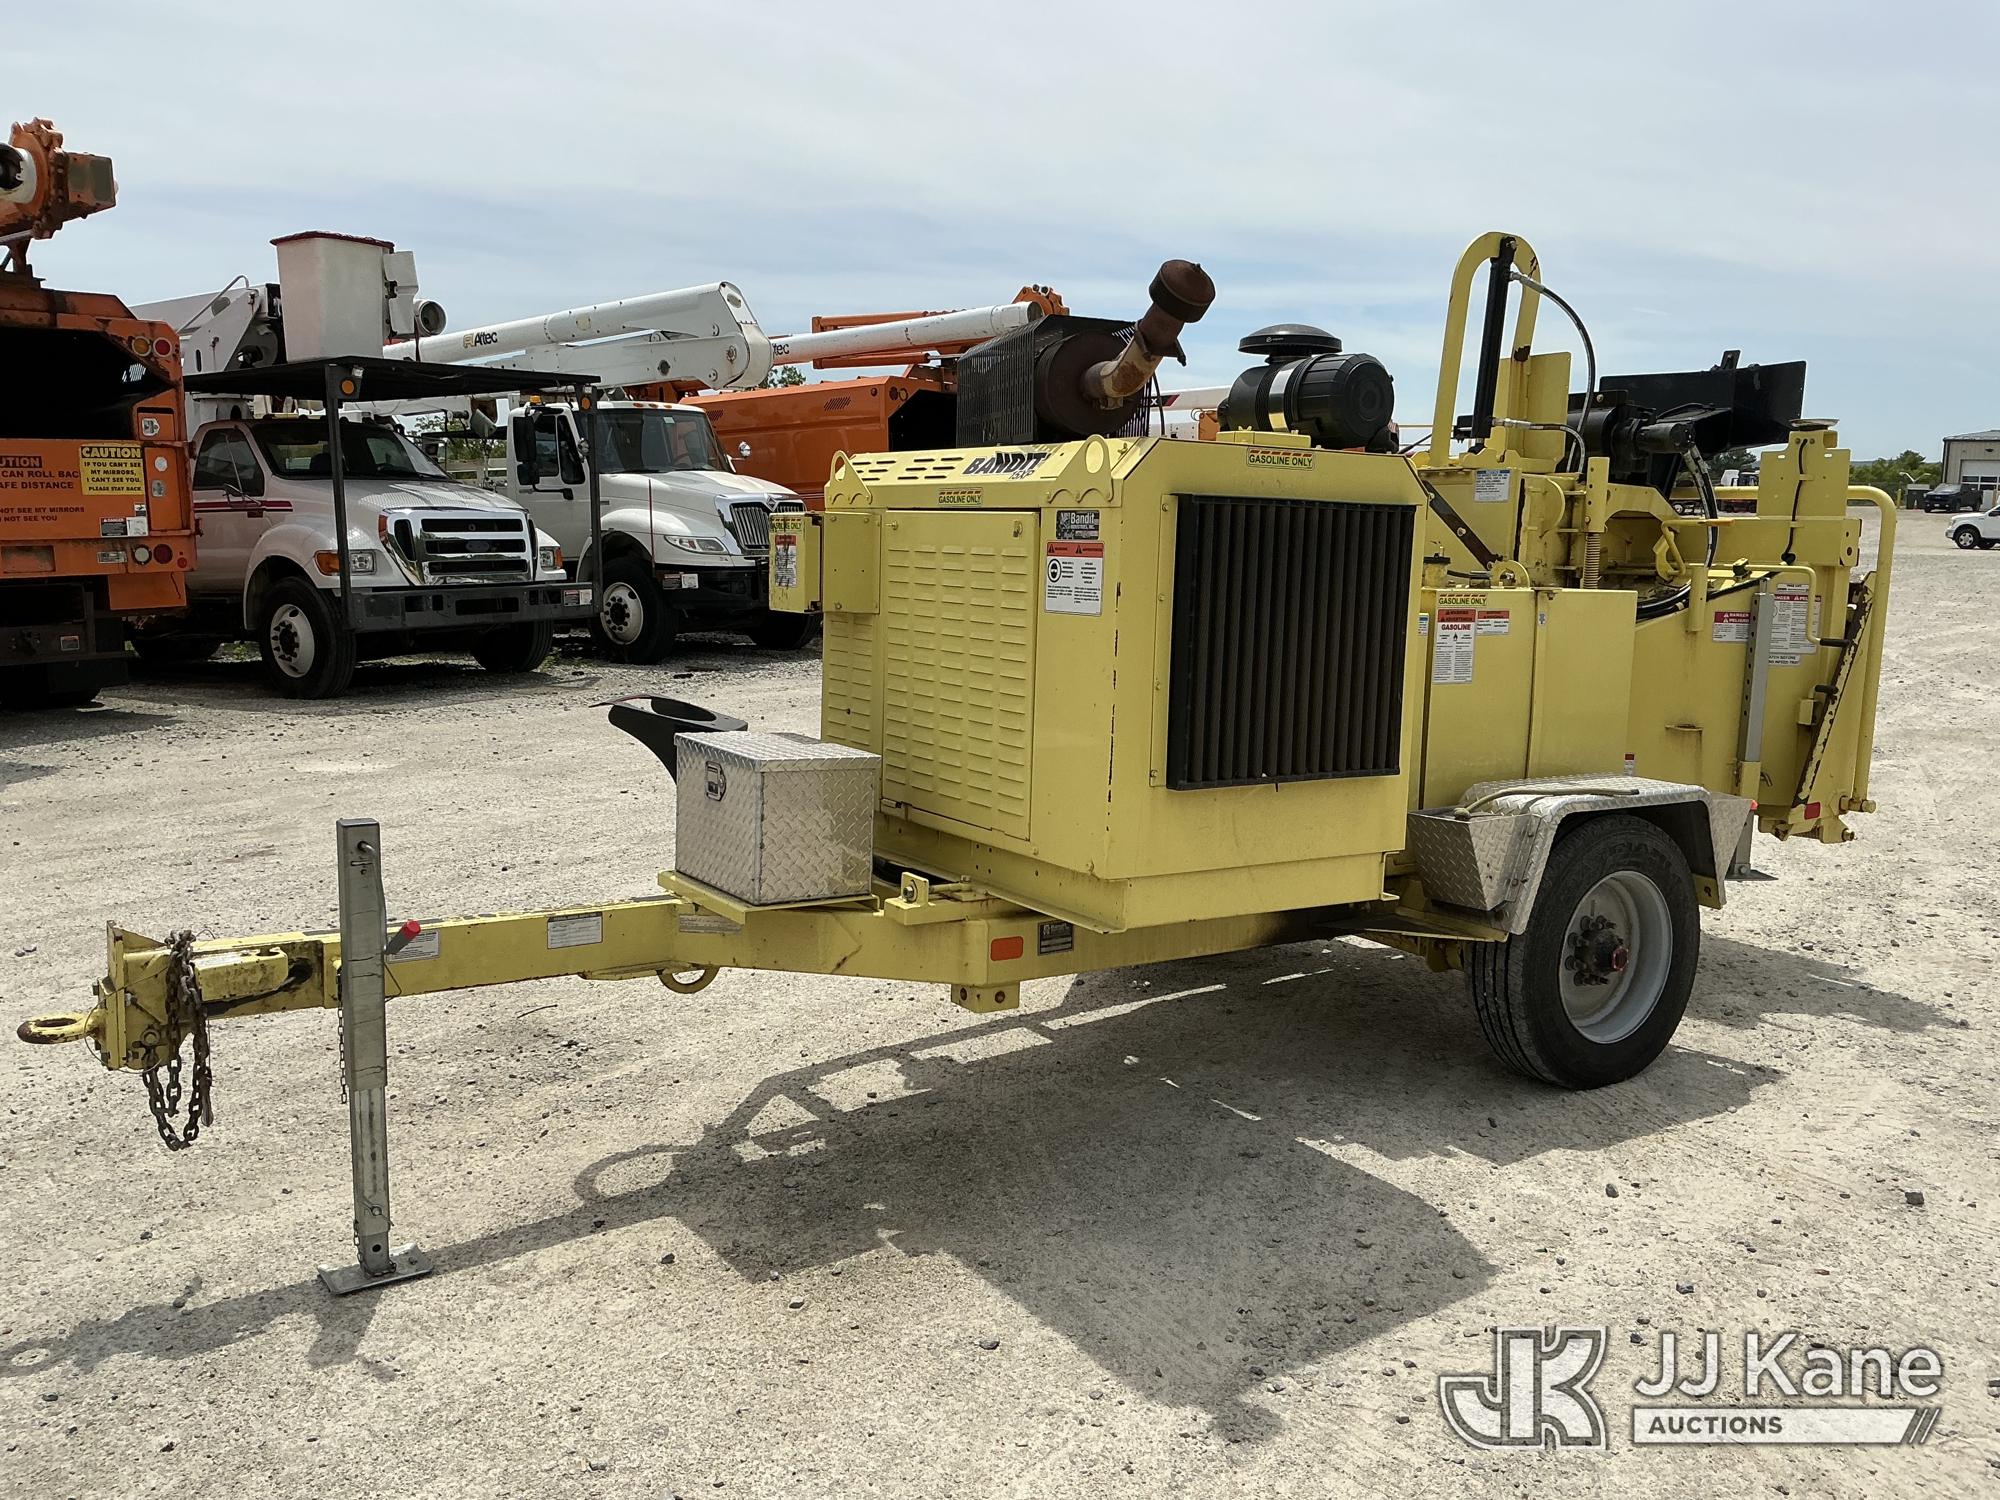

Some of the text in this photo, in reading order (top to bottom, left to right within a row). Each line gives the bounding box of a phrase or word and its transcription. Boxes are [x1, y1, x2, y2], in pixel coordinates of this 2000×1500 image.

[475, 332, 498, 346] Altec
[82, 447, 141, 458] CAUTION
[962, 452, 1048, 475] BANDIT
[1248, 454, 1313, 467] GASOLINE ONLY
[1, 470, 24, 478] CAN
[58, 470, 81, 479] BAC
[21, 481, 74, 489] DISTANCE
[938, 494, 982, 504] GASOLINE ONLY
[1070, 512, 1095, 524] Bandit
[1439, 597, 1487, 605] GASOLINE ONLY
[1441, 623, 1471, 631] GASOLINE
